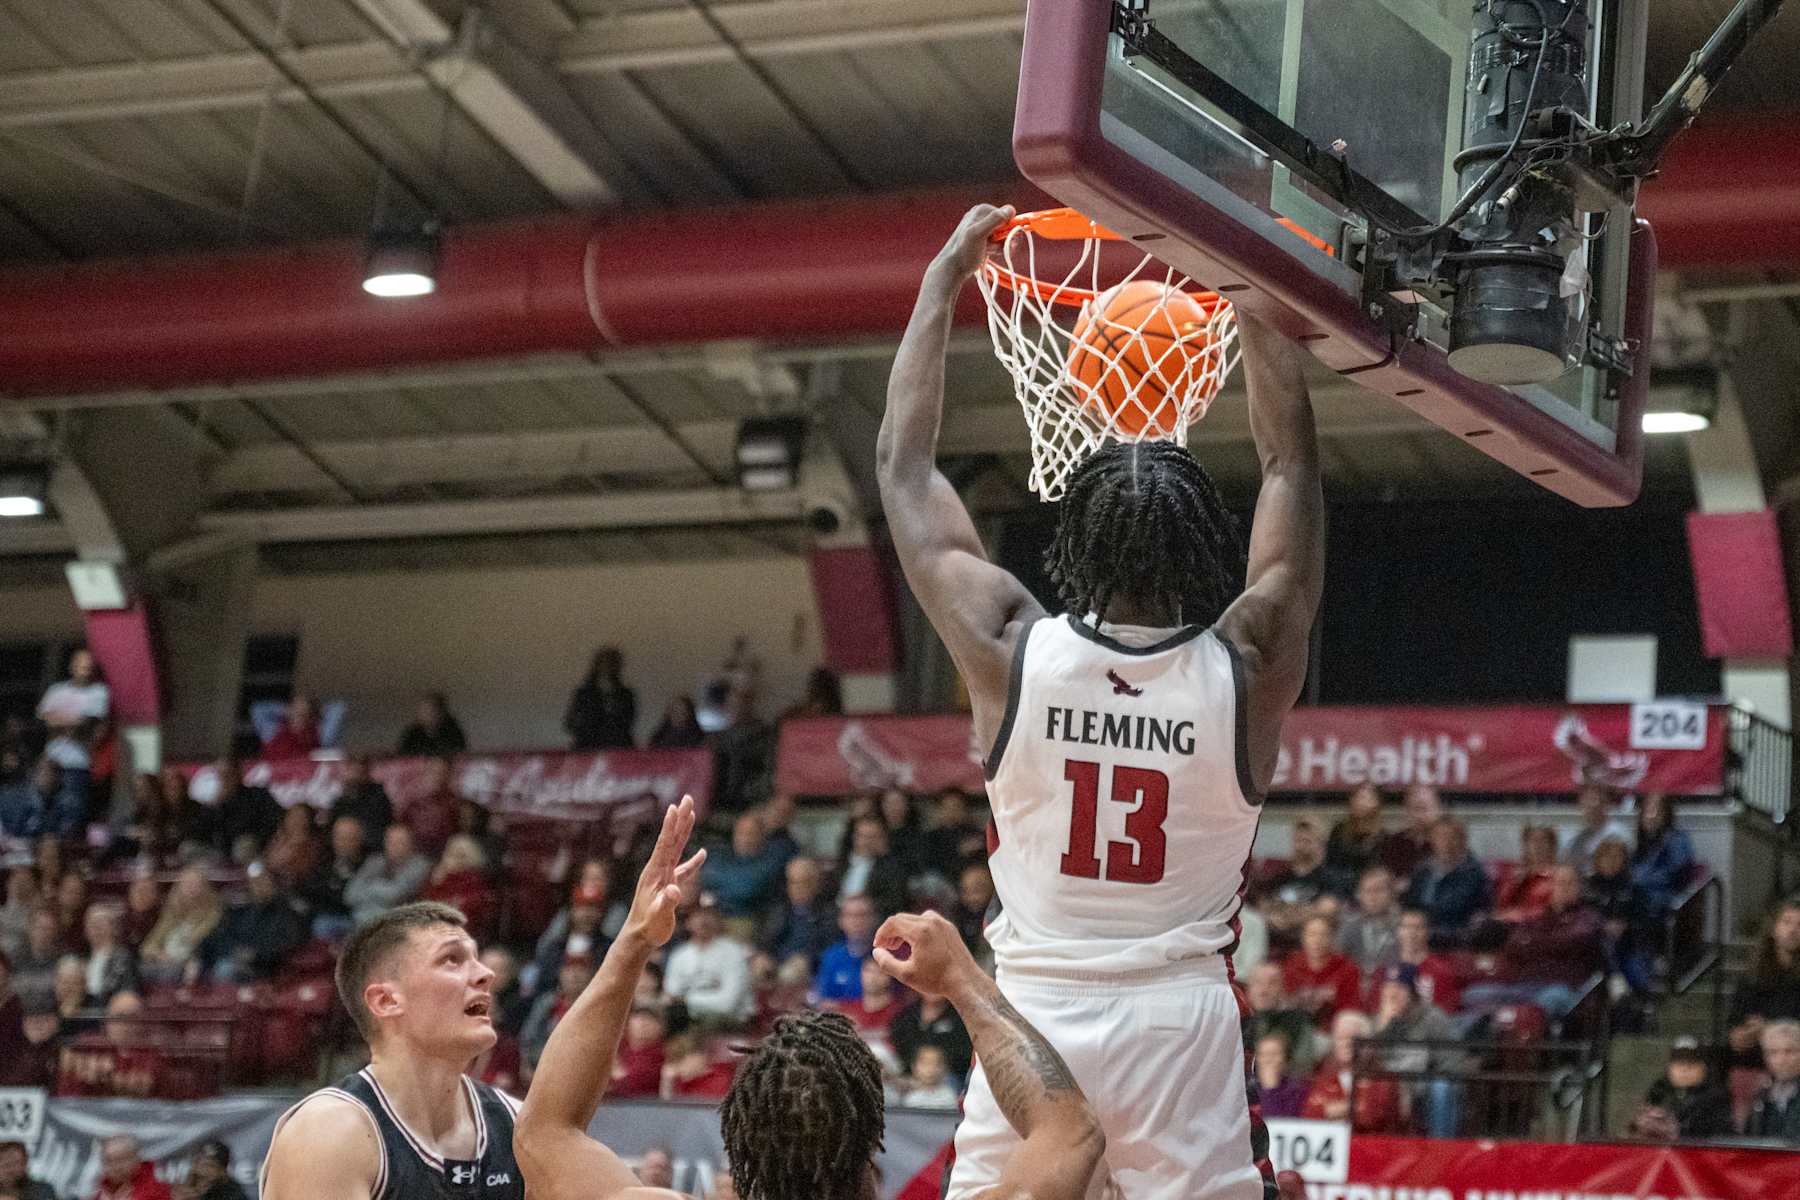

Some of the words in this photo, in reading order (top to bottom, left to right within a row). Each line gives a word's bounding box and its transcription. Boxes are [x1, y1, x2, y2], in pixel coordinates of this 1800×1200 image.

[1046, 706, 1196, 756] FLEMING
[1641, 712, 1698, 738] 204
[1300, 735, 1470, 785] Health
[1060, 758, 1170, 885] 13
[1275, 1134, 1334, 1167] 104
[486, 1173, 511, 1187] CAA
